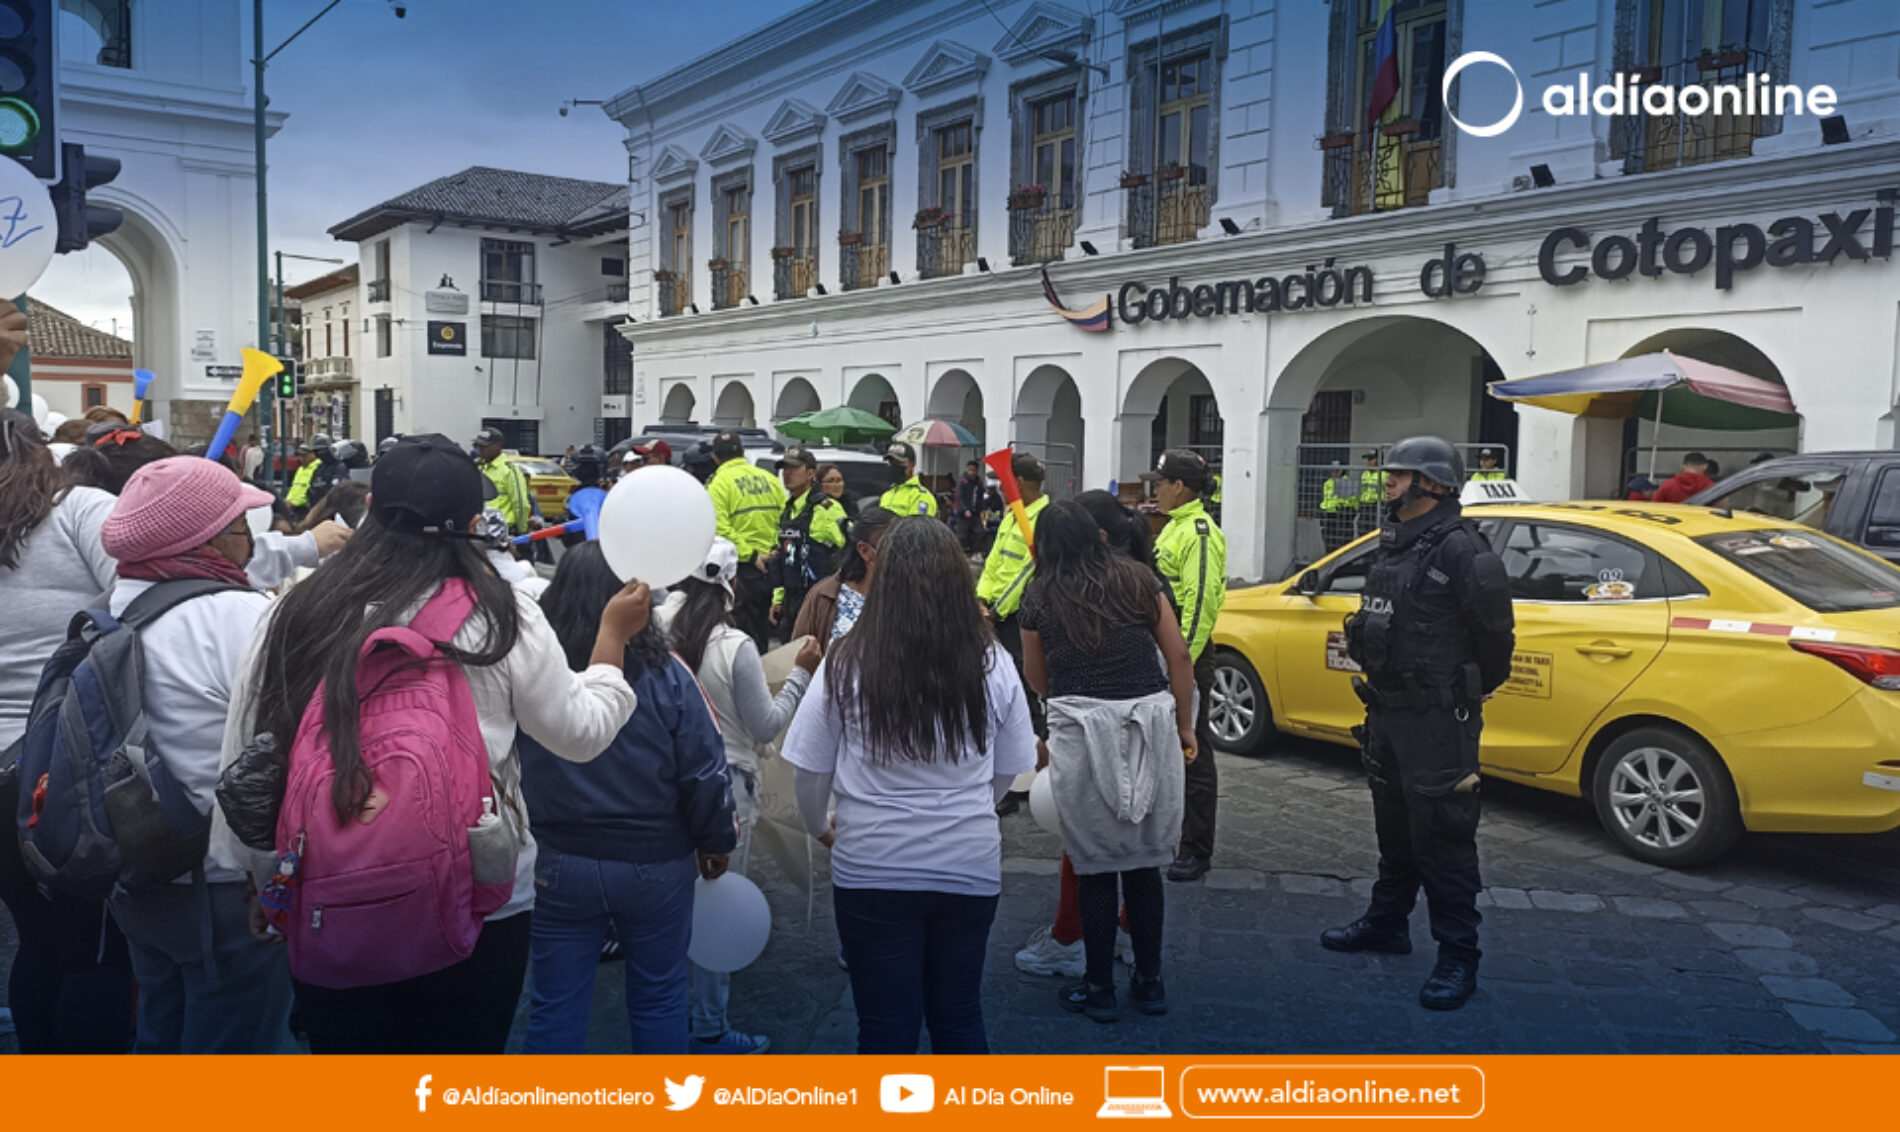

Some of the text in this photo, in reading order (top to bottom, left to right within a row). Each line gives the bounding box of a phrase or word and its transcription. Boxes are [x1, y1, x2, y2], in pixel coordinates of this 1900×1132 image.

[0, 195, 44, 248] Z
[1420, 243, 1487, 298] de
[1538, 188, 1896, 290] Cotopaxi
[1480, 483, 1517, 498] TAXI
